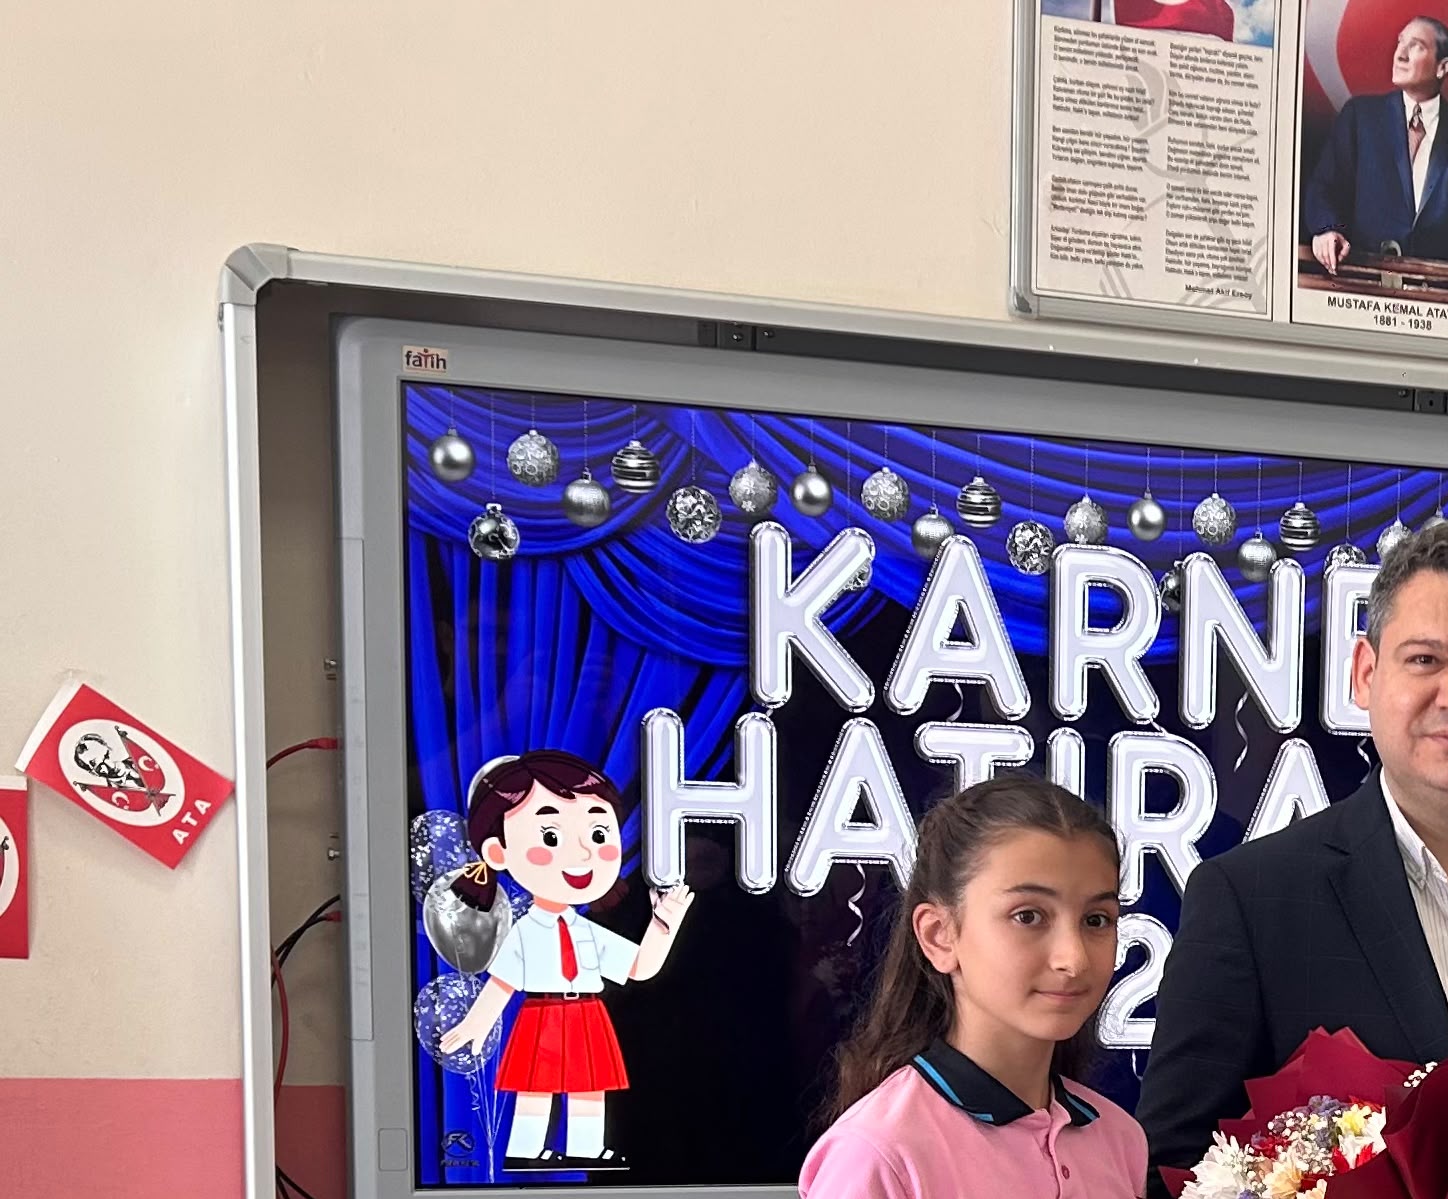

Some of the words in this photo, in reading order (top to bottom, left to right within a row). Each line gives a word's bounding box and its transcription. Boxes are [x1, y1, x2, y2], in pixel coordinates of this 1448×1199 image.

[1327, 295, 1381, 313] MUSTAFA
[1384, 302, 1423, 317] KEMAL
[1374, 314, 1397, 328] 1881
[1408, 318, 1433, 331] 1938
[172, 798, 211, 844] ATA
